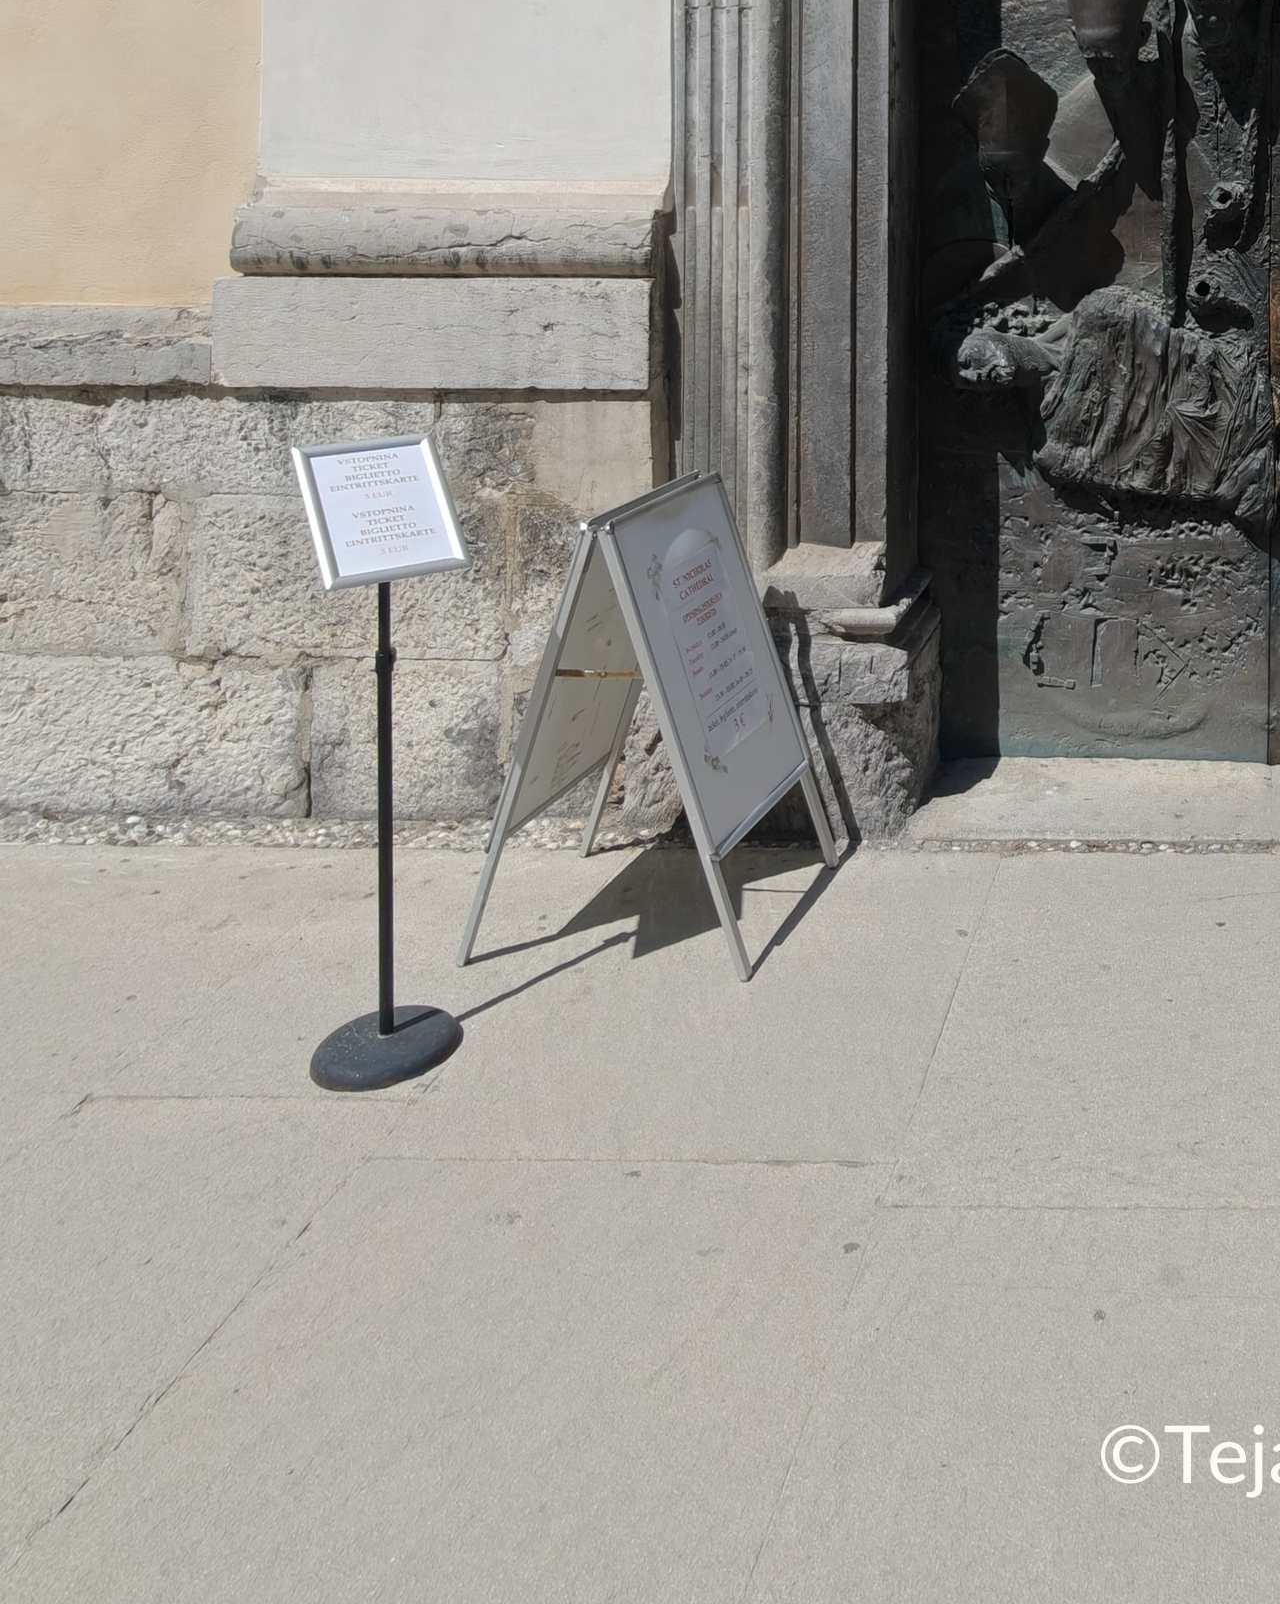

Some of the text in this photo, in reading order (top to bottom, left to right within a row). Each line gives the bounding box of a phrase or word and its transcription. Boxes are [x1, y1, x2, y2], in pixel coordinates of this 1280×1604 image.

[336, 453, 399, 465] VSTOPNINA
[350, 462, 389, 472] TICKET
[345, 468, 401, 482] BIGLIETTO
[329, 474, 420, 493] EINTRITTSKARTE
[373, 490, 394, 499] EUR
[352, 505, 415, 519] VSTOPNINA
[366, 515, 406, 526] TICKET
[359, 521, 417, 537] BIGLIETTO
[345, 528, 437, 548] EINTRITTSKARTE
[388, 544, 410, 554] EUR
[682, 558, 712, 584] NICHOLAS
[679, 573, 715, 601] CATHEDRAL
